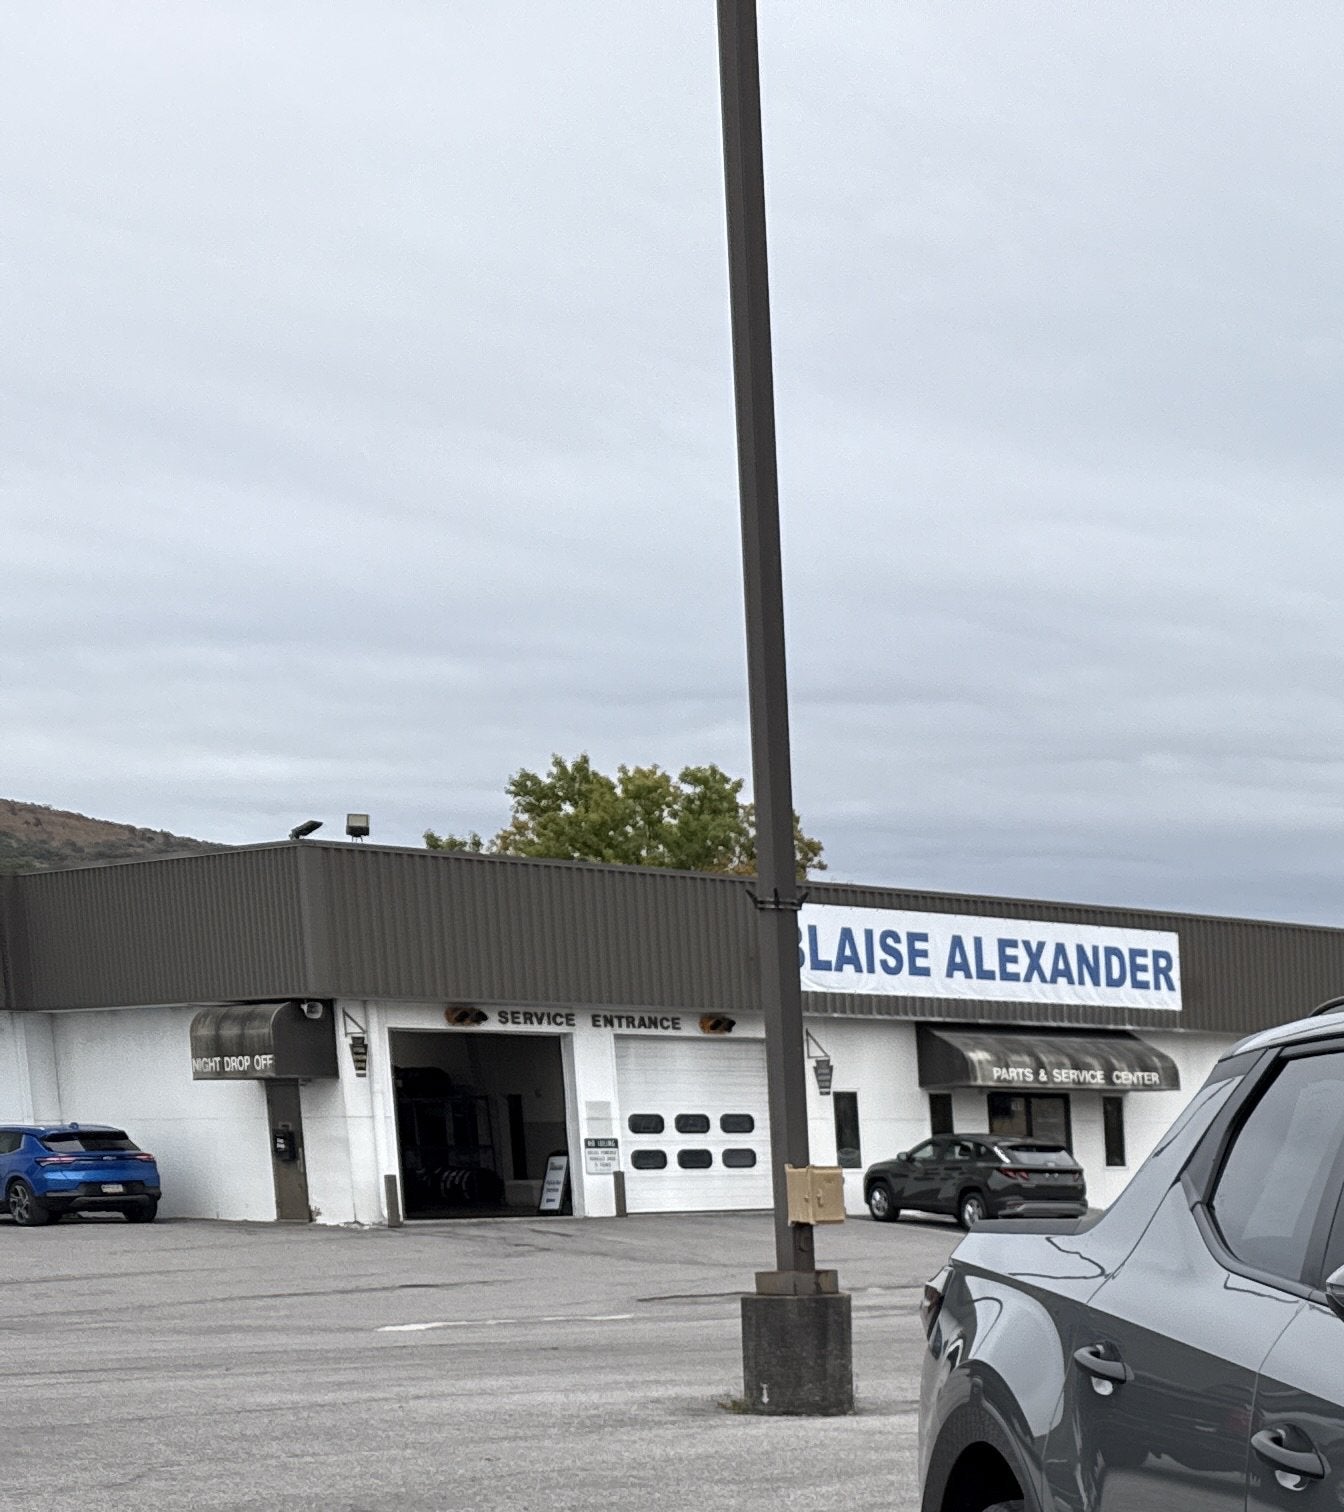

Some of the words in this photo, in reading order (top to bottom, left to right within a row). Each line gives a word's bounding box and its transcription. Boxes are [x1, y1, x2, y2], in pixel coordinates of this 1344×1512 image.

[799, 924, 931, 977] LAISE
[945, 934, 1177, 992] ALEXANDER
[498, 1010, 576, 1027] SERVICE
[591, 1014, 682, 1031] ENTRANCE
[192, 1055, 222, 1073] NIGHT
[223, 1055, 251, 1072] DROP
[253, 1054, 275, 1071] OFF
[992, 1067, 1034, 1082] PARTS
[1038, 1068, 1048, 1082] &
[1053, 1068, 1106, 1084] SERVICE
[1112, 1070, 1160, 1085] CENTER
